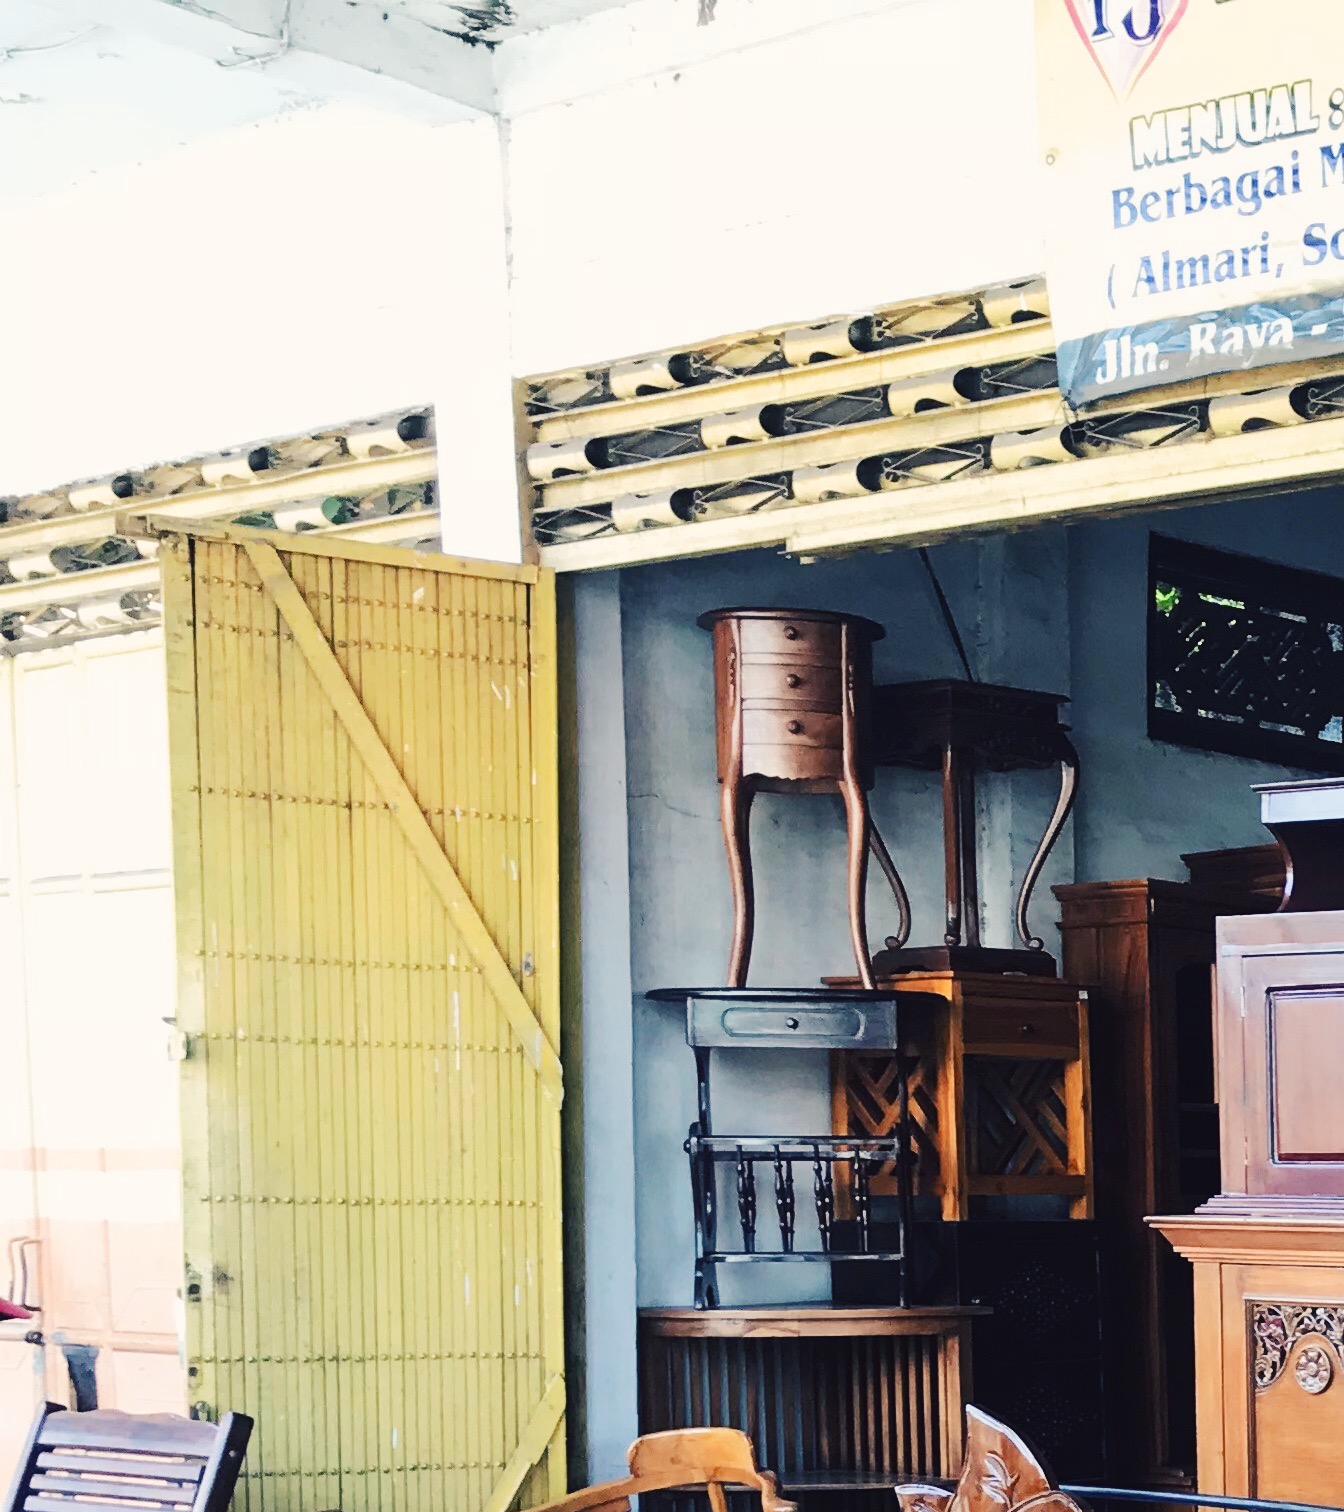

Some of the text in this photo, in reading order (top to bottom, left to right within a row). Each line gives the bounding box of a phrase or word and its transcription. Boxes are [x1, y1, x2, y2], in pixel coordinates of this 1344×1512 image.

[1129, 79, 1320, 171] MENJUAL
[1111, 149, 1302, 230] Berbagai
[1132, 230, 1284, 298] Almari,
[1095, 334, 1169, 386] Jln.
